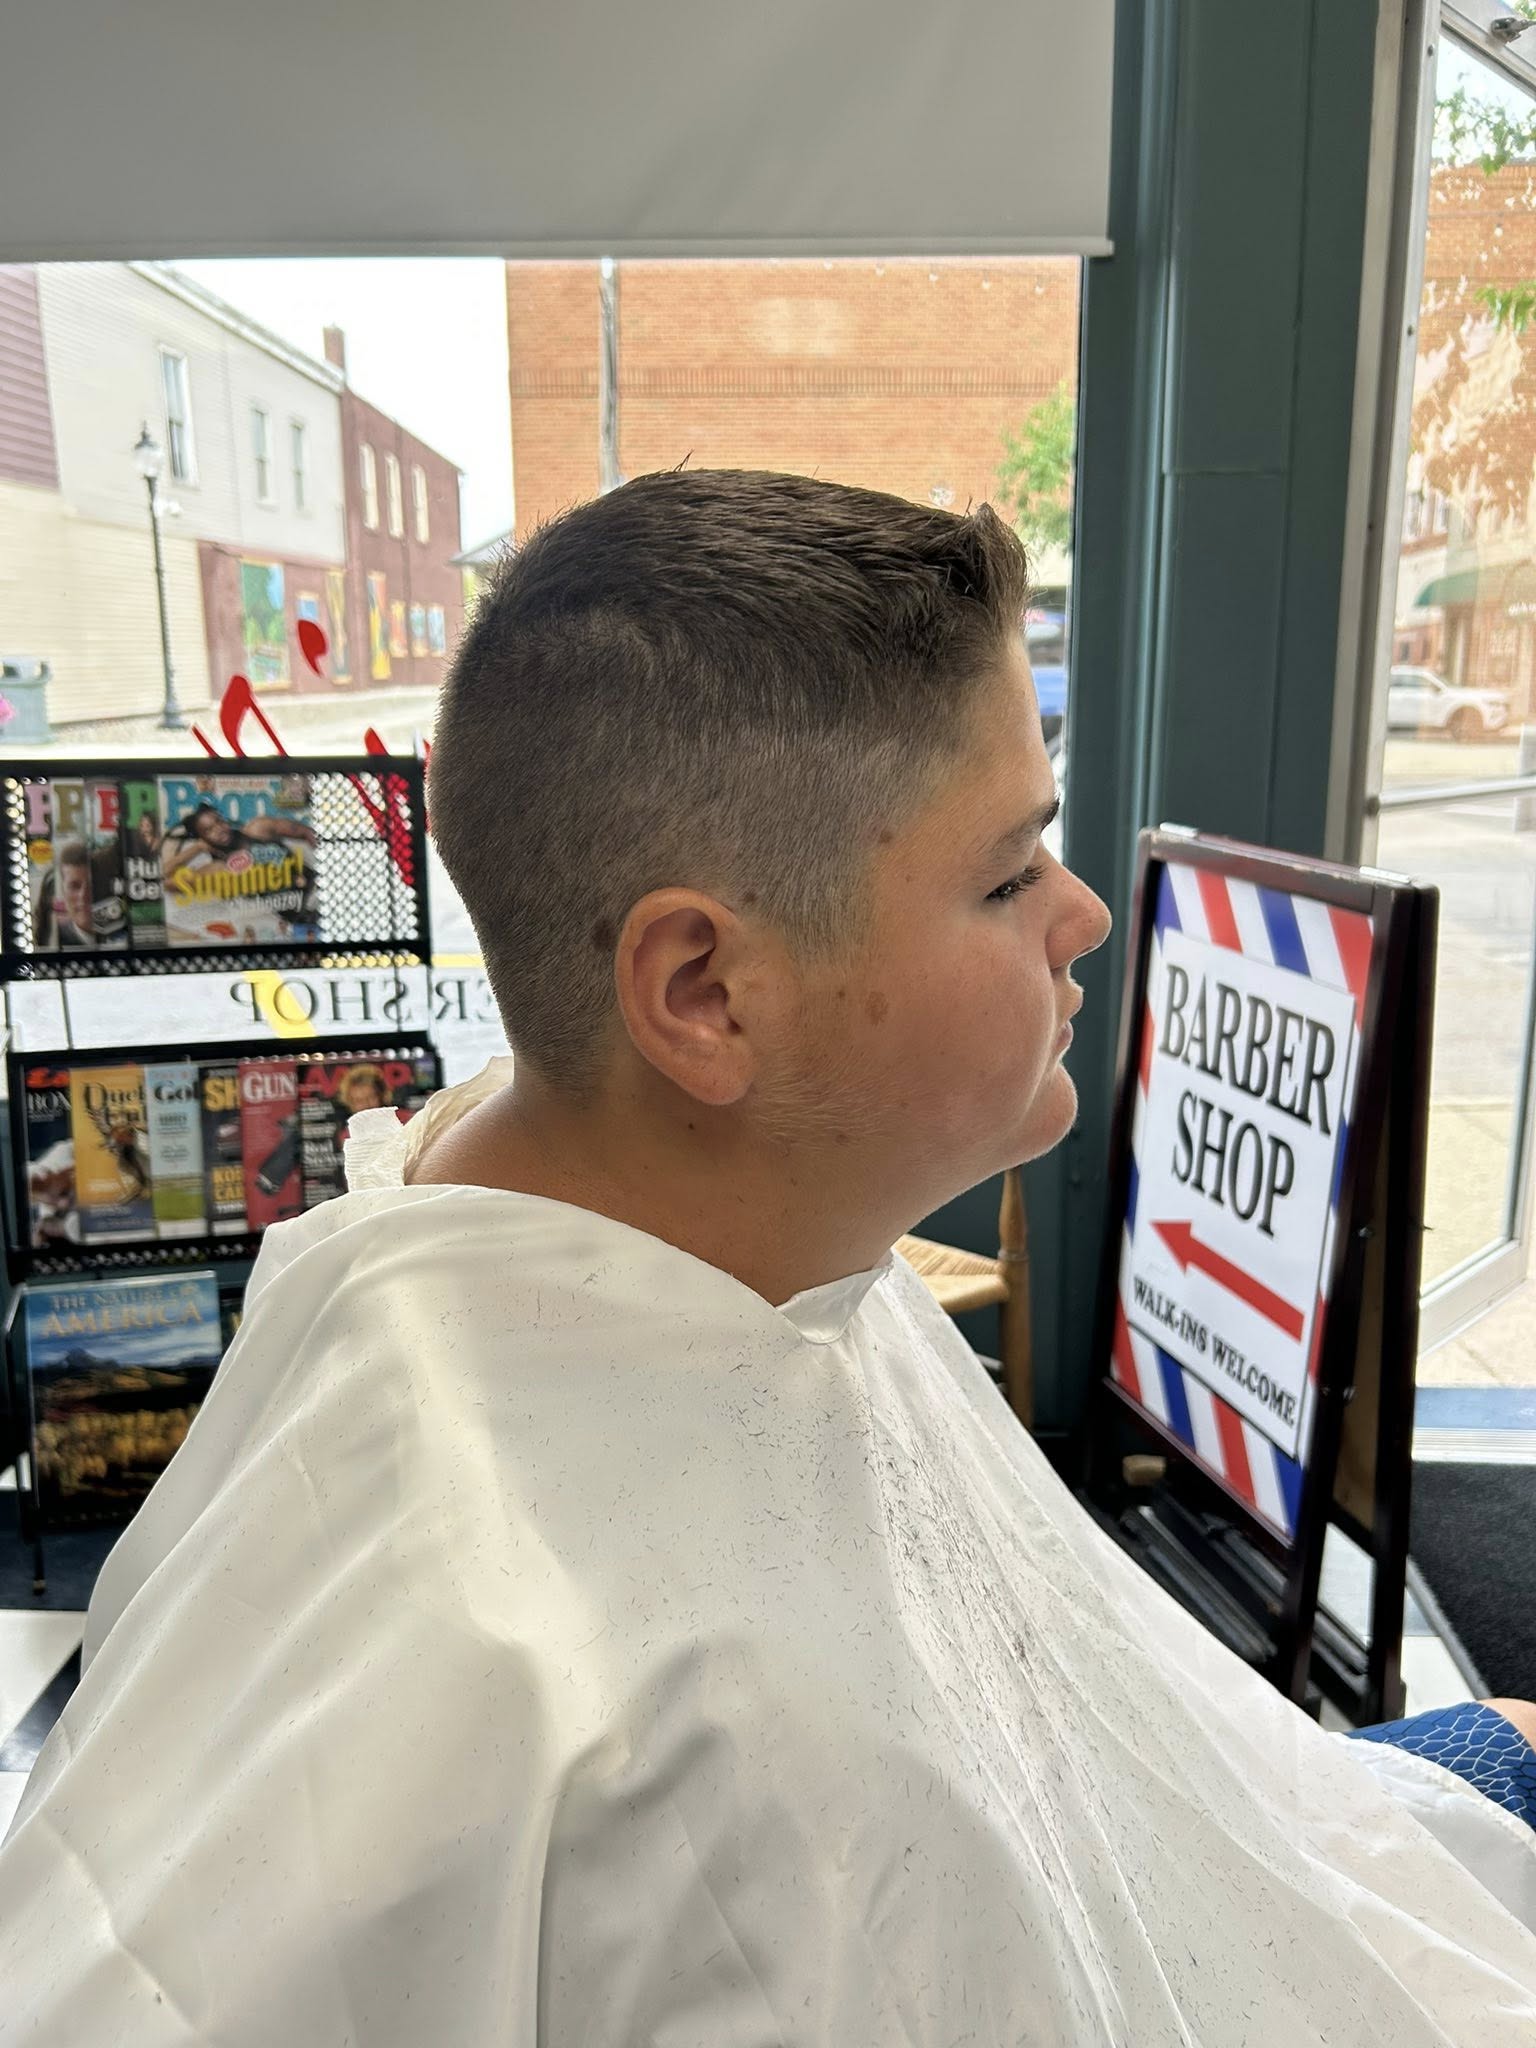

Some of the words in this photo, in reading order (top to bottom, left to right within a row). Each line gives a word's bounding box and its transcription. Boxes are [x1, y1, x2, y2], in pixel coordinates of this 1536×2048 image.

[174, 850, 305, 907] Summer!
[154, 1080, 199, 1103] Gol
[1158, 963, 1335, 1137] BARBER
[1171, 1089, 1295, 1239] SHOP
[41, 1300, 203, 1337] AMERICA
[1132, 1276, 1209, 1354] WALK-INS
[1211, 1333, 1297, 1428] WELCOME
